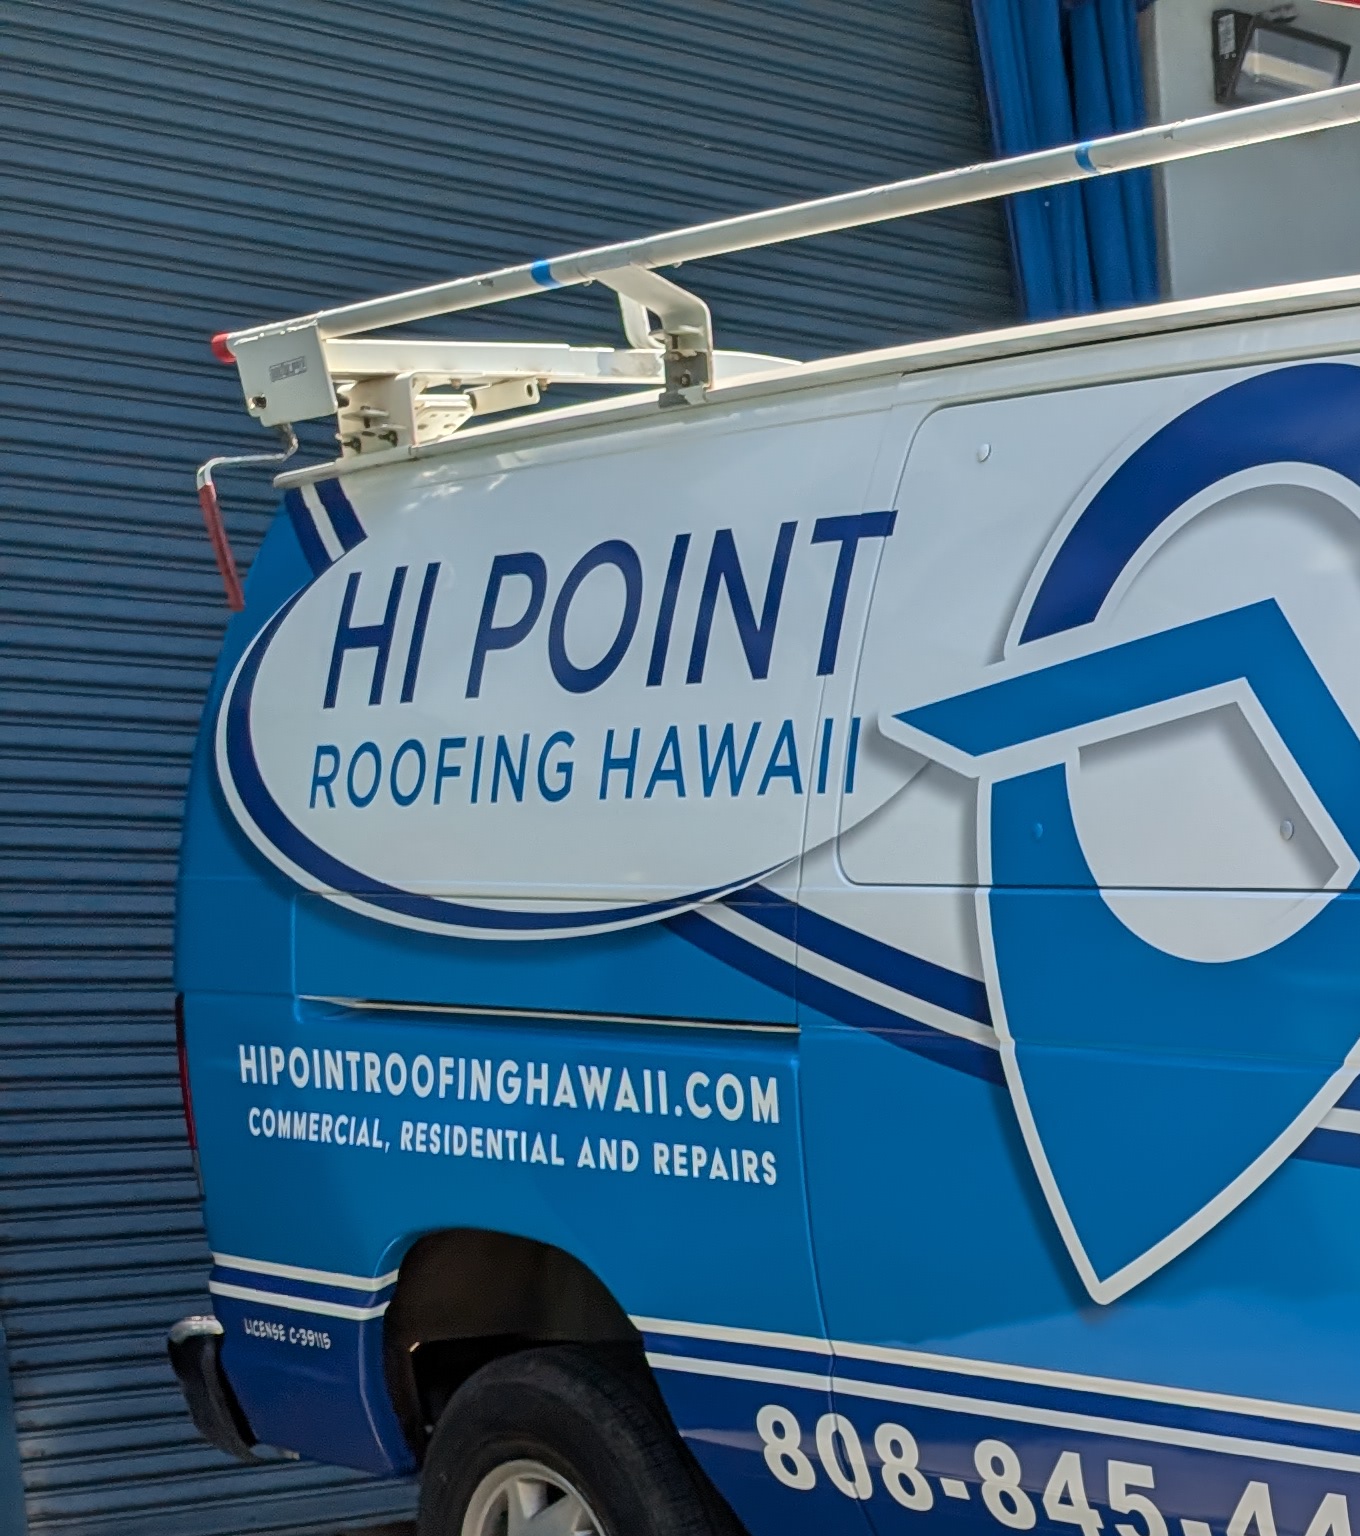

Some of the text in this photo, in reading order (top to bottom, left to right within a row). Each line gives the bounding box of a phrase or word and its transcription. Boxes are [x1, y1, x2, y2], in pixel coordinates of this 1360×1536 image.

[322, 509, 899, 710] HI POINT
[309, 716, 861, 809] ROOFING HAWAII
[238, 1044, 780, 1124] HIPOINTROOFINGHAWAII.COM
[248, 1106, 777, 1186] COMMERCIAL, RESIDENTIAL AND REPAIRS
